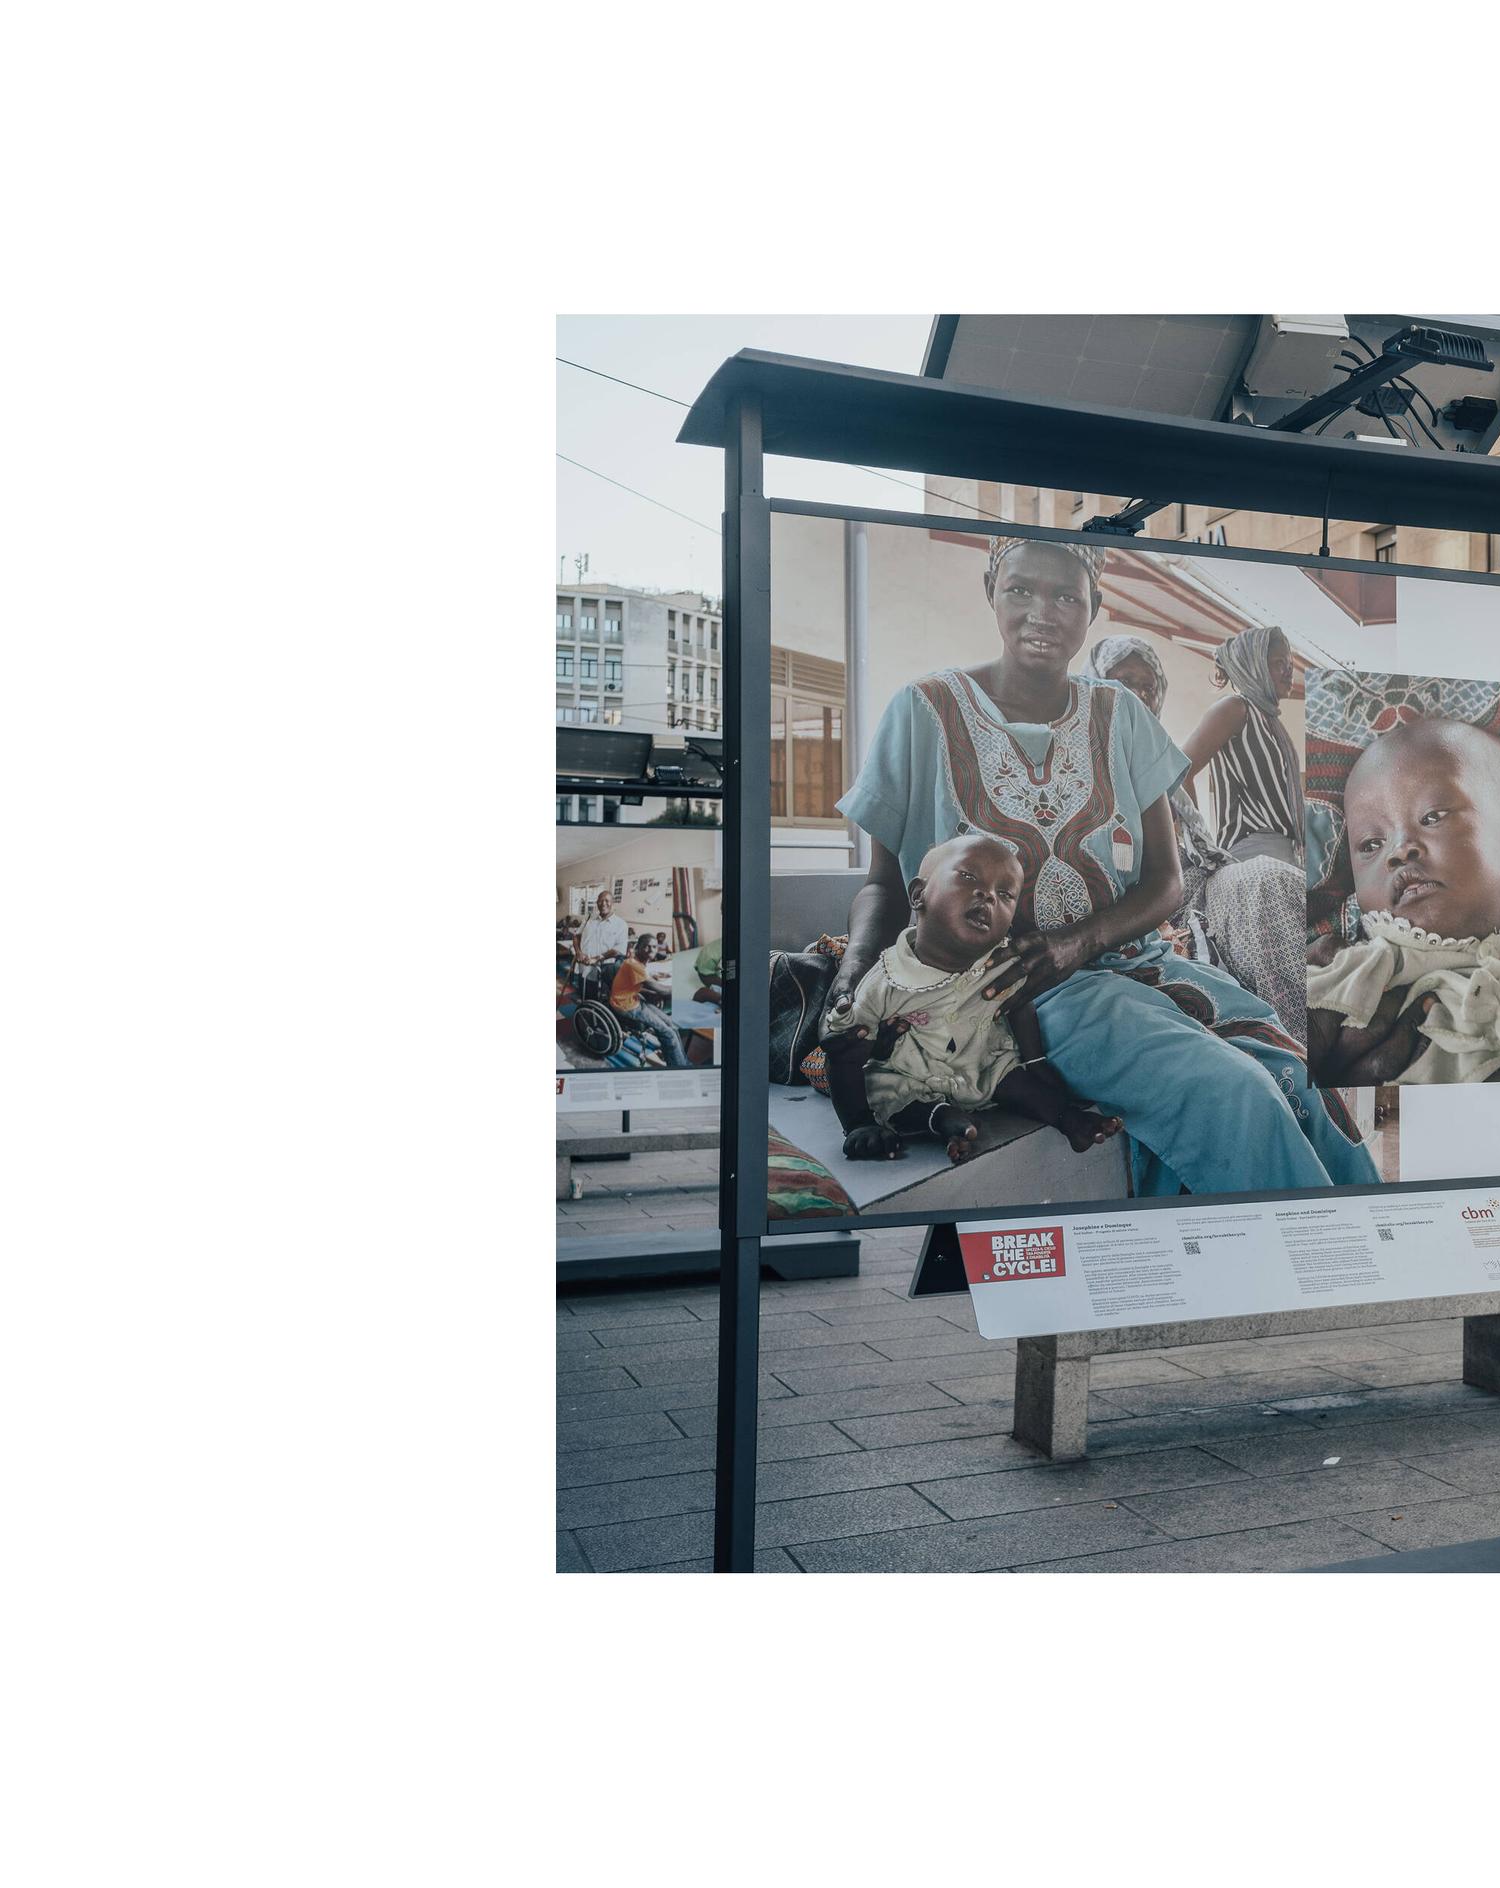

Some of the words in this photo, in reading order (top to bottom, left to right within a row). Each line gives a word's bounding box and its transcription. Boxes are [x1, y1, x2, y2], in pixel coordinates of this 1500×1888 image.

[1461, 1206, 1494, 1220] cbm
[991, 1231, 1055, 1251] BREAK
[992, 1248, 1025, 1263] THE
[993, 1258, 1057, 1277] CYCLE!
